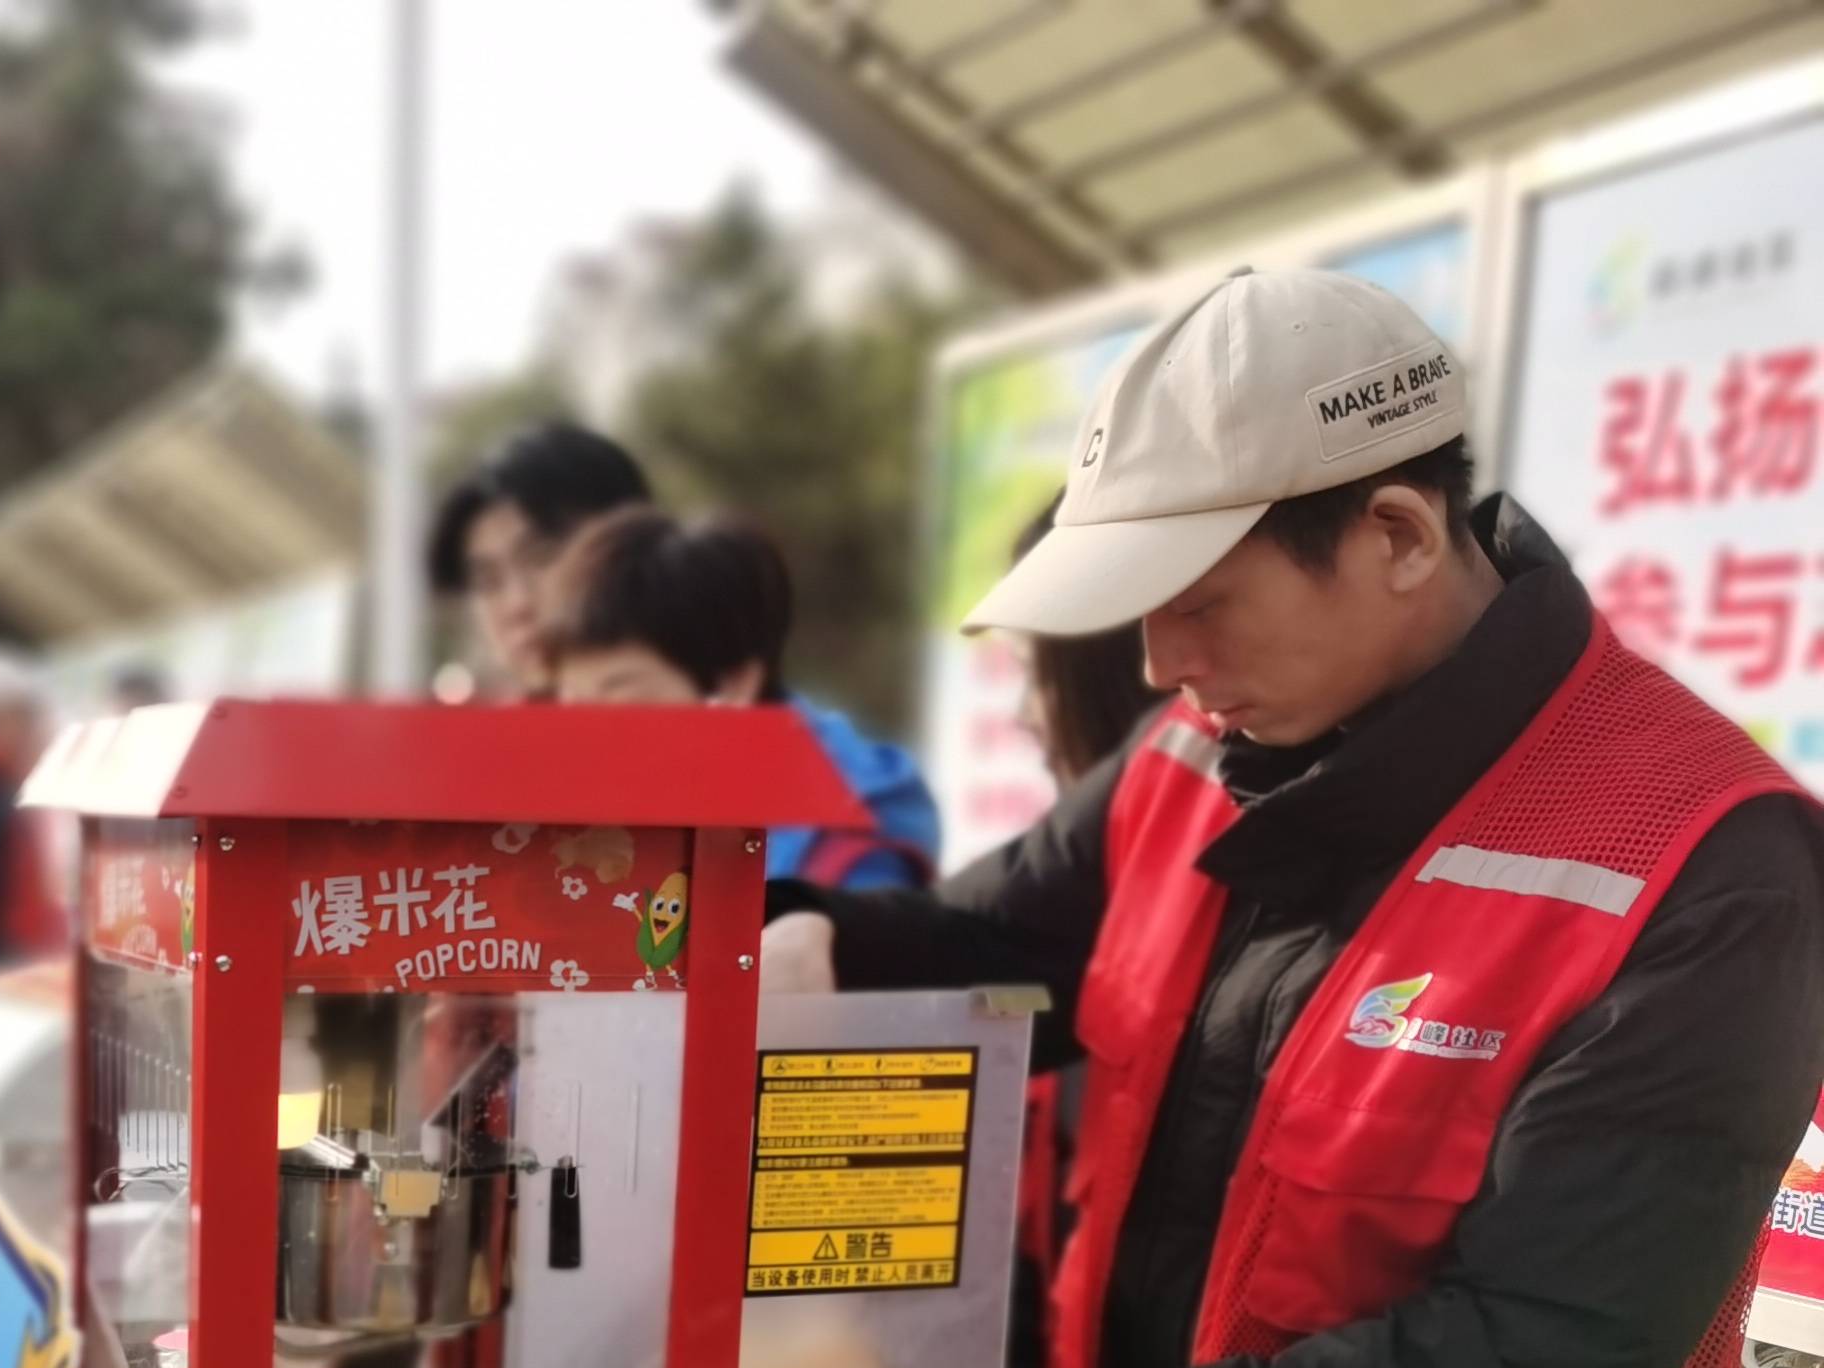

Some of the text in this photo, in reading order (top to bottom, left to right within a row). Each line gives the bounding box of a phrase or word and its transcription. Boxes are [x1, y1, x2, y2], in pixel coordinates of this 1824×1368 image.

[1319, 354, 1451, 424] MAKE A BRAVE
[1367, 389, 1438, 429] VINTAGE STYLE
[1601, 548, 1824, 690] 参与
[291, 863, 497, 957] 爆米花
[395, 938, 542, 988] POPCORN
[845, 1232, 893, 1260] 警告
[751, 1263, 952, 1289] 当设备使用时 禁止人员离开
